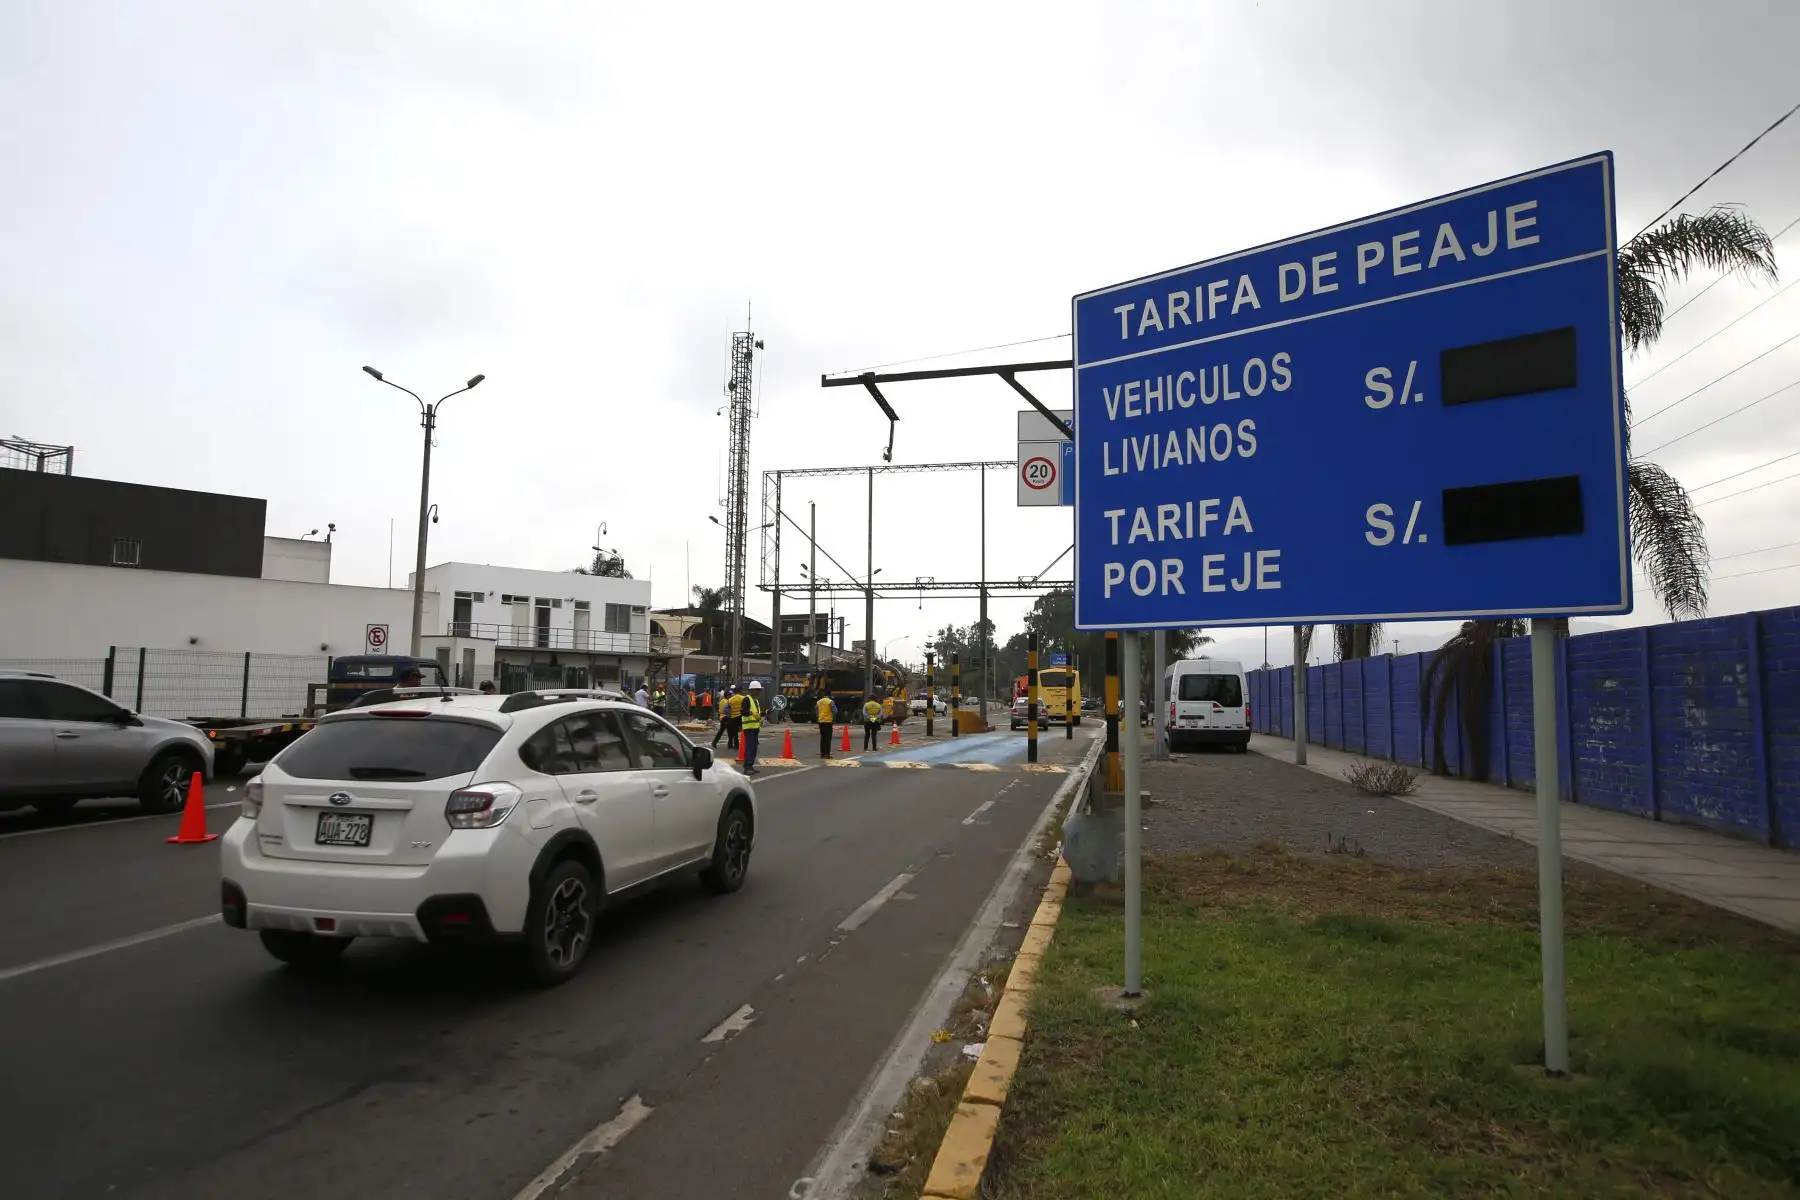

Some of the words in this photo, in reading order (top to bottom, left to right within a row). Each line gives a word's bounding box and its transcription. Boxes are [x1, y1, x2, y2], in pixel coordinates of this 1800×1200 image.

[1114, 274, 1262, 340] TARIFA
[1279, 252, 1339, 306] DE
[1358, 199, 1540, 285] PEAJE
[1103, 352, 1292, 421] VEHICULOS
[1364, 361, 1425, 408] S/.
[1030, 464, 1048, 478] 20
[1104, 418, 1257, 476] LIVIANOS
[1104, 495, 1254, 546] TARIFA
[1366, 500, 1428, 547] S/.
[1105, 558, 1186, 598] POR
[1203, 550, 1282, 593] EJE
